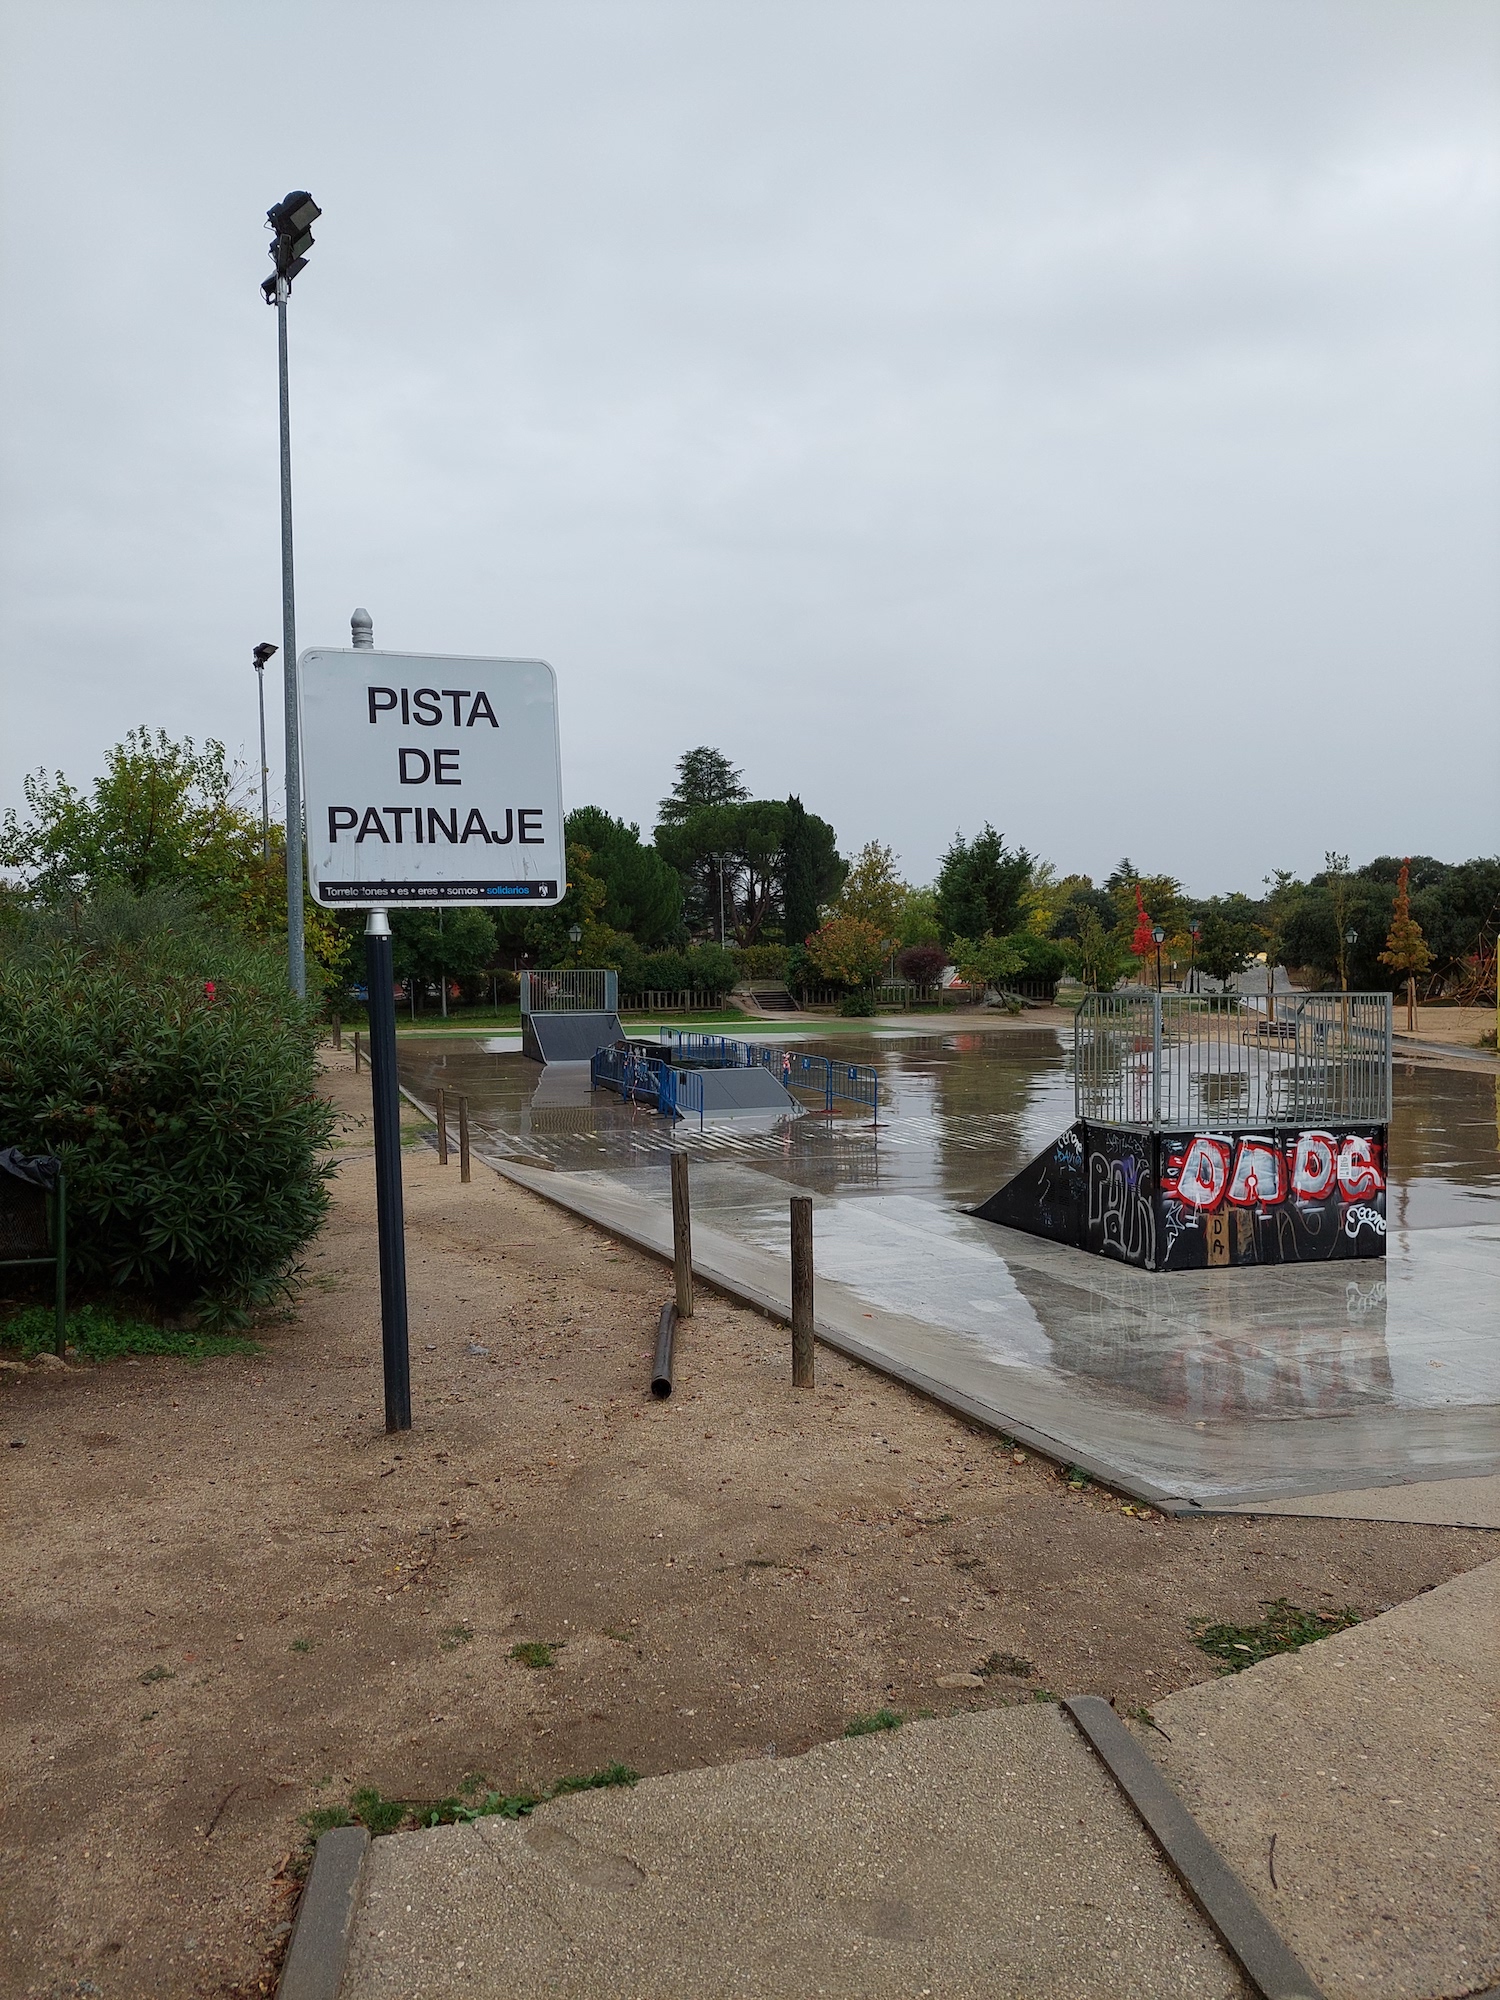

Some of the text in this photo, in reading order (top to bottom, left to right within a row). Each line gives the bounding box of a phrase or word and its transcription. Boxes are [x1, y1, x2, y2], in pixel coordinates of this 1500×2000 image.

[368, 686, 500, 728] PISTA
[398, 747, 462, 786] DE
[327, 806, 545, 845] PATINAJE
[417, 887, 439, 895] eres
[446, 886, 479, 895] somos
[486, 885, 530, 895] solidarios
